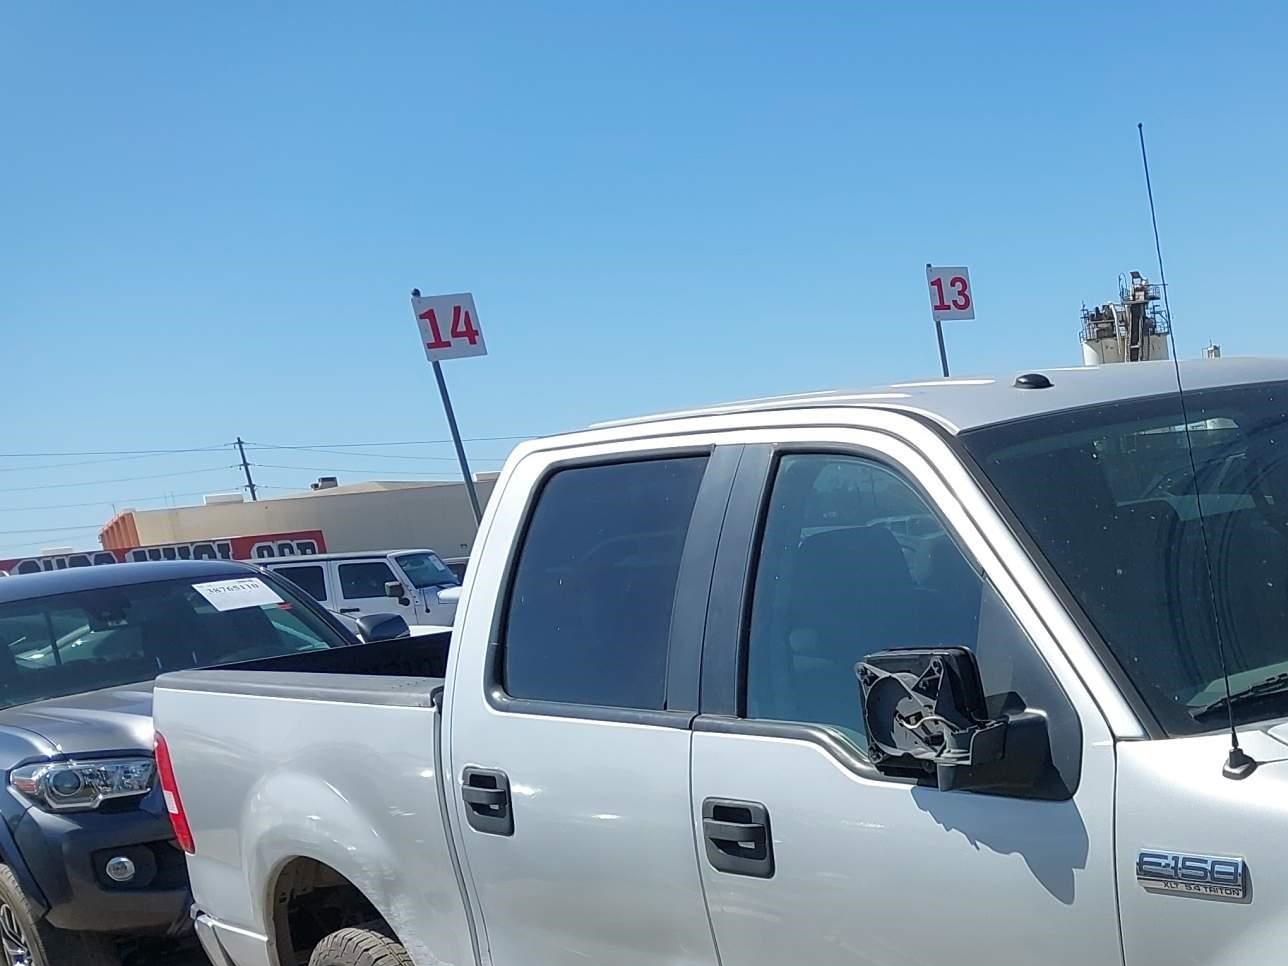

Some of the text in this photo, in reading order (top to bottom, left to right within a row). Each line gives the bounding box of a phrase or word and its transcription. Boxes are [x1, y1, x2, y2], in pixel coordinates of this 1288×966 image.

[930, 276, 971, 311] 13
[418, 305, 480, 349] 14
[1202, 886, 1241, 897] TRITON
